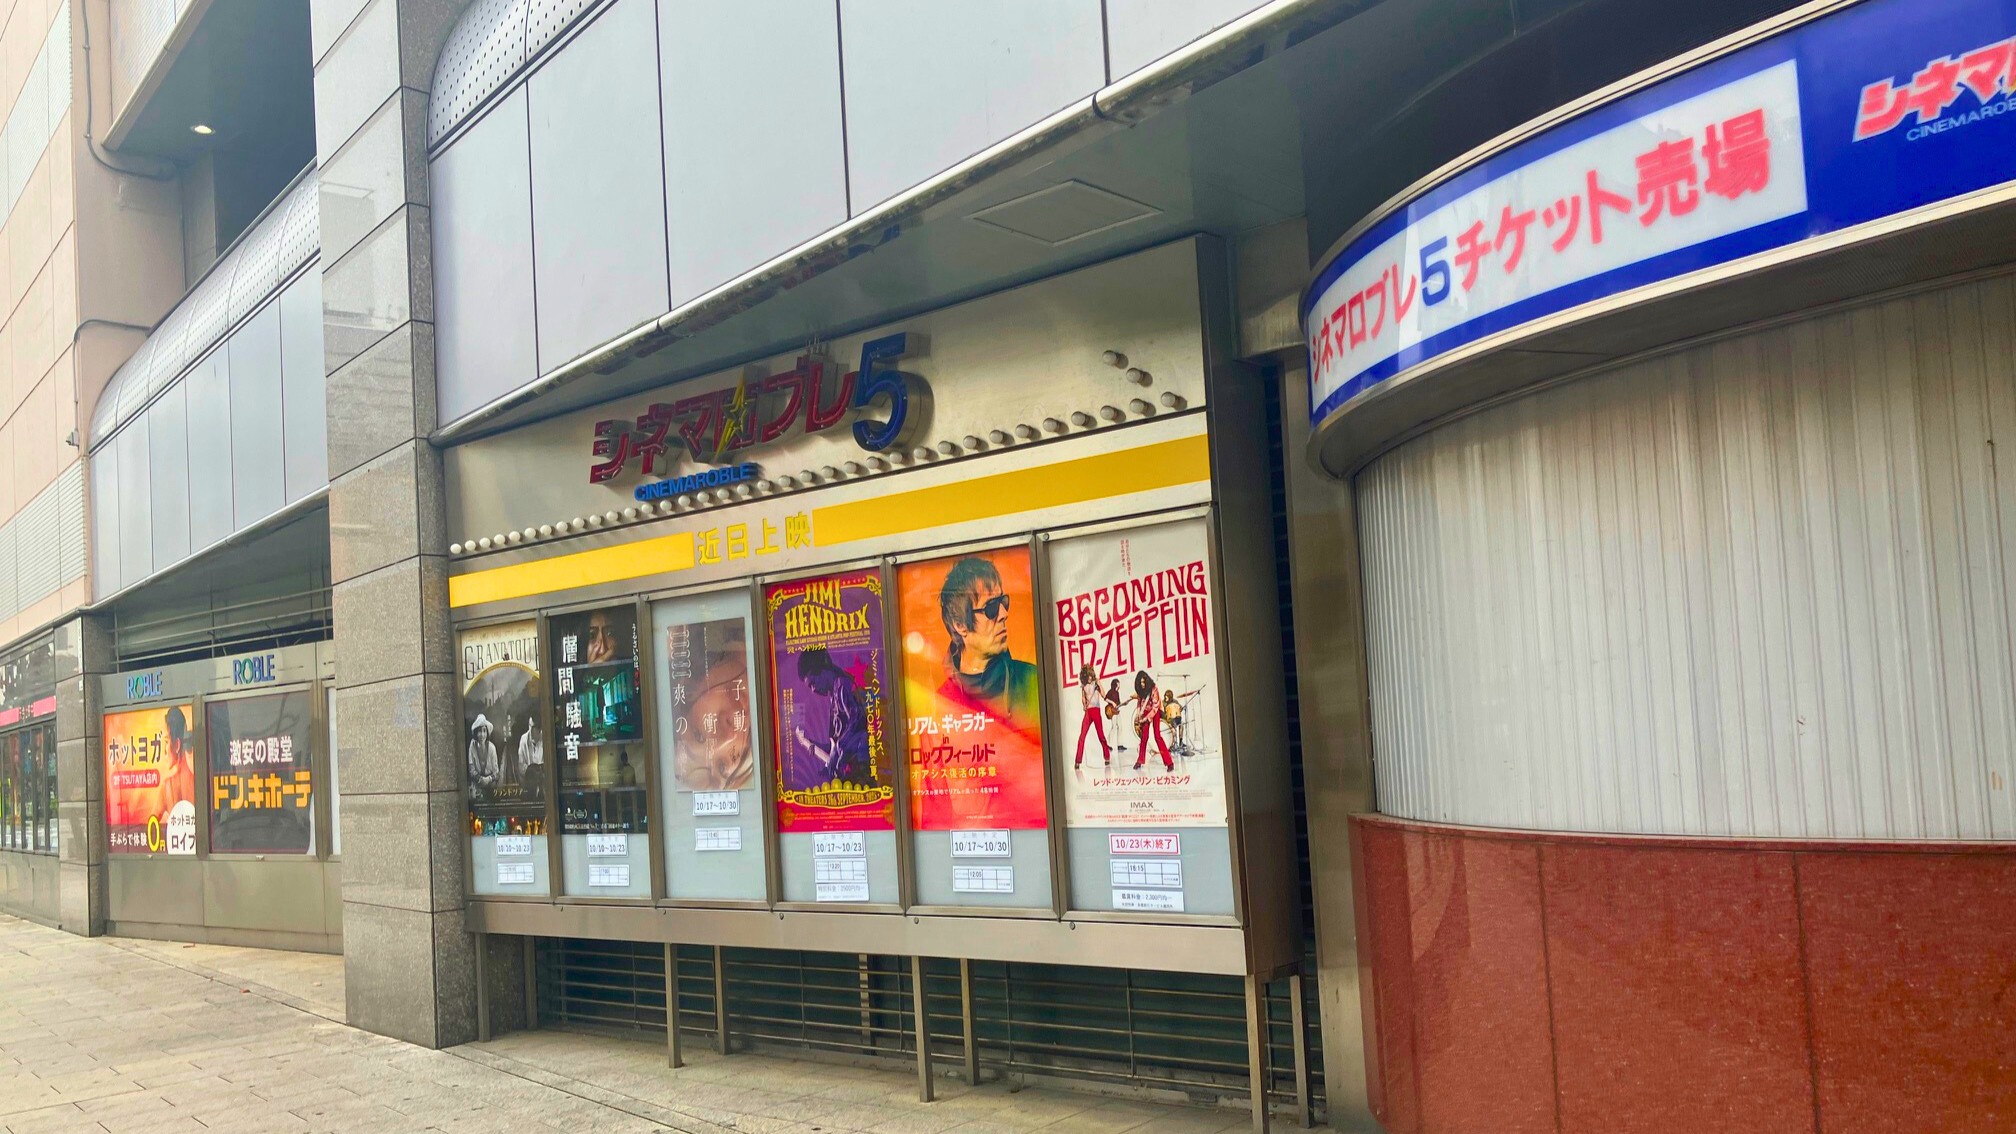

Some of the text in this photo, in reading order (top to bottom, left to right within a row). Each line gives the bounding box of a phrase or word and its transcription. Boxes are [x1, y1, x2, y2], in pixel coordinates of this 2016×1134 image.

[589, 332, 908, 484] シネマロブレ5
[633, 462, 757, 503] CINEMAROBLE
[697, 512, 811, 566] 近日上映
[803, 579, 842, 610] JIMI
[1056, 561, 1207, 637] BECOMING
[785, 603, 870, 639] HENDRIX
[233, 654, 275, 685] ROBLE
[464, 641, 506, 680] GRAND
[127, 671, 163, 699] ROBLE
[908, 711, 995, 735] リアム・ギャラガー
[109, 731, 163, 766] ホットヨガ
[229, 736, 294, 765] 激安の殿堂
[942, 734, 950, 744] in
[911, 744, 996, 765] ロックフィールド
[122, 773, 158, 786] TSUTAYA店内
[912, 766, 998, 780] オアシス復活の序章
[1130, 801, 1154, 809] IMAX
[1115, 837, 1173, 850] 10/23(木)終了
